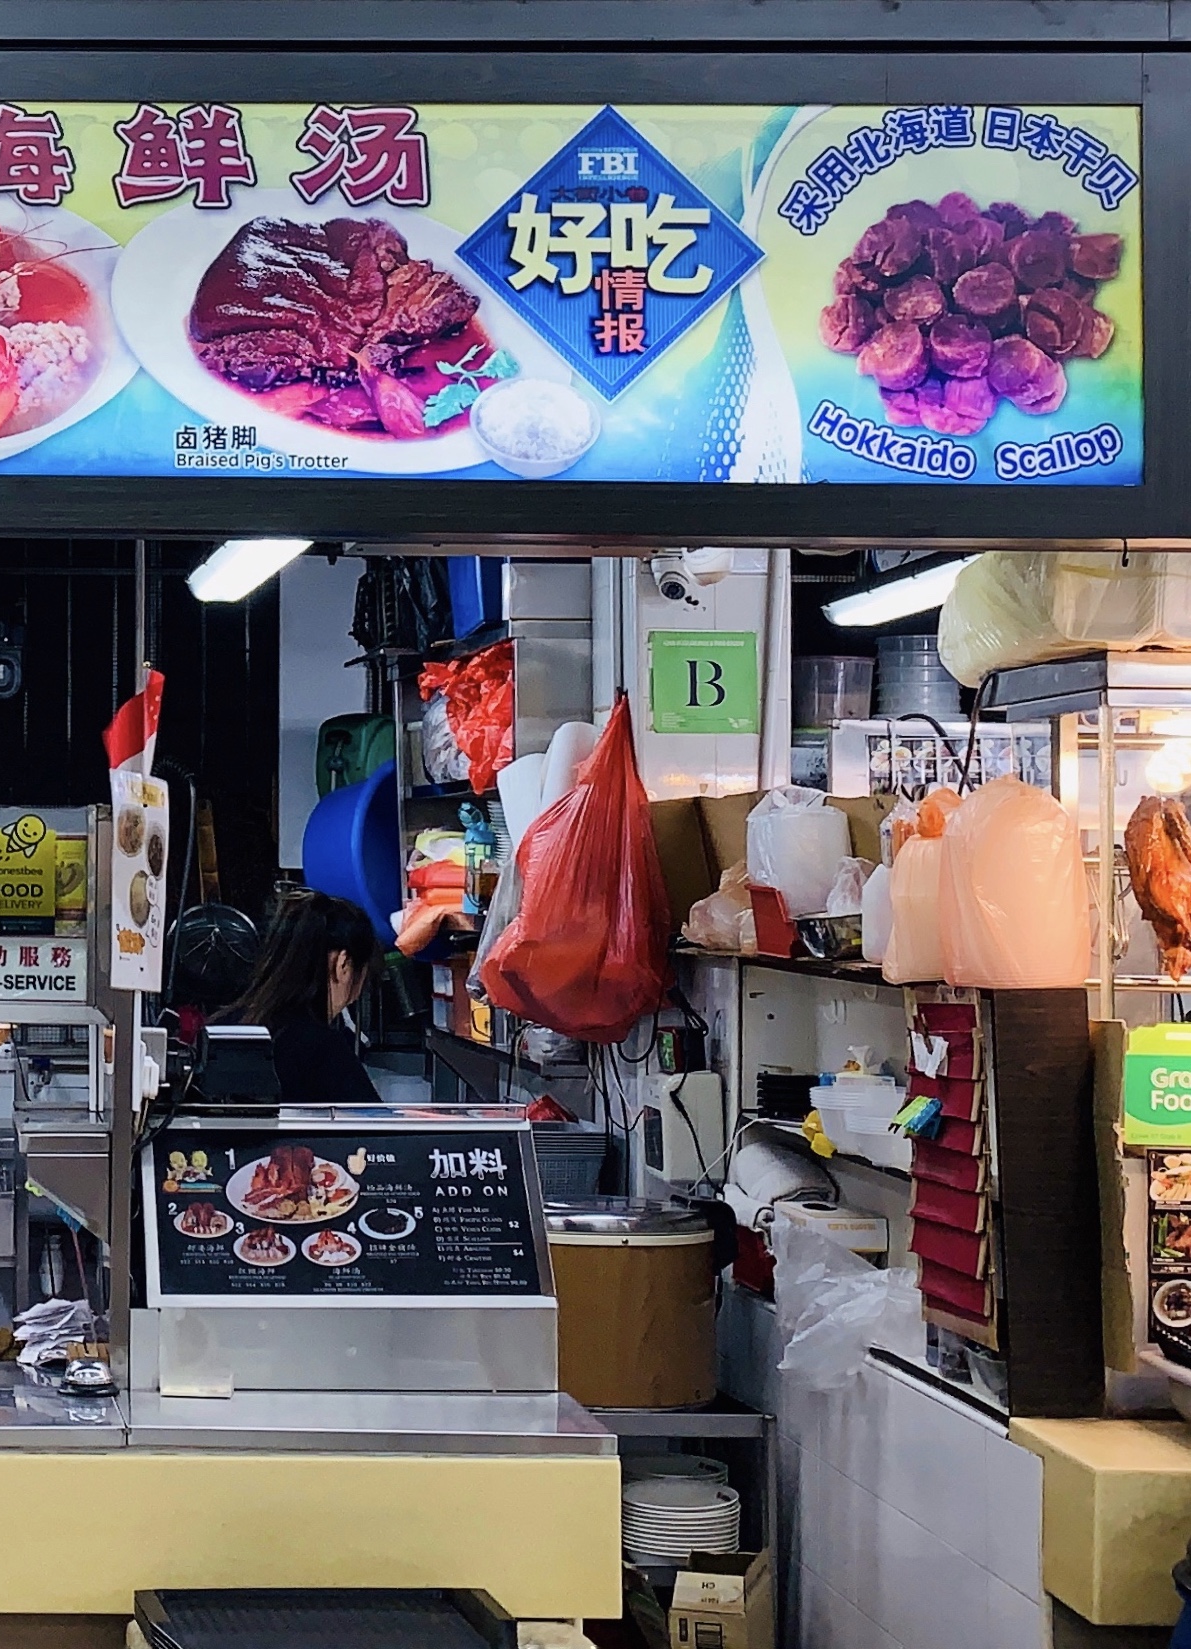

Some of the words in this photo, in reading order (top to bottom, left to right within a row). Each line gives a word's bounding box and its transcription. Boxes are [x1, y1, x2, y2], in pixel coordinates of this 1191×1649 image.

[577, 152, 639, 175] FBI
[781, 106, 974, 233] 采用北海道
[985, 109, 1138, 208] 日本干贝
[508, 192, 714, 295] 好吃
[594, 268, 647, 353] 情报
[176, 425, 257, 450] 卤猪脚
[810, 403, 974, 475] Hokkaido
[177, 453, 239, 467] Braised
[244, 454, 283, 469] Pig's
[288, 455, 349, 468] Trotter
[996, 425, 1121, 477] Scallop
[685, 659, 726, 707] B
[224, 1148, 236, 1170] 1
[428, 1147, 508, 1181] 加料
[435, 1185, 472, 1197] ADD
[482, 1185, 508, 1197] ON
[167, 1202, 178, 1216] 2
[413, 1206, 424, 1219] 5
[234, 1221, 245, 1235] 3
[346, 1221, 357, 1235] 4
